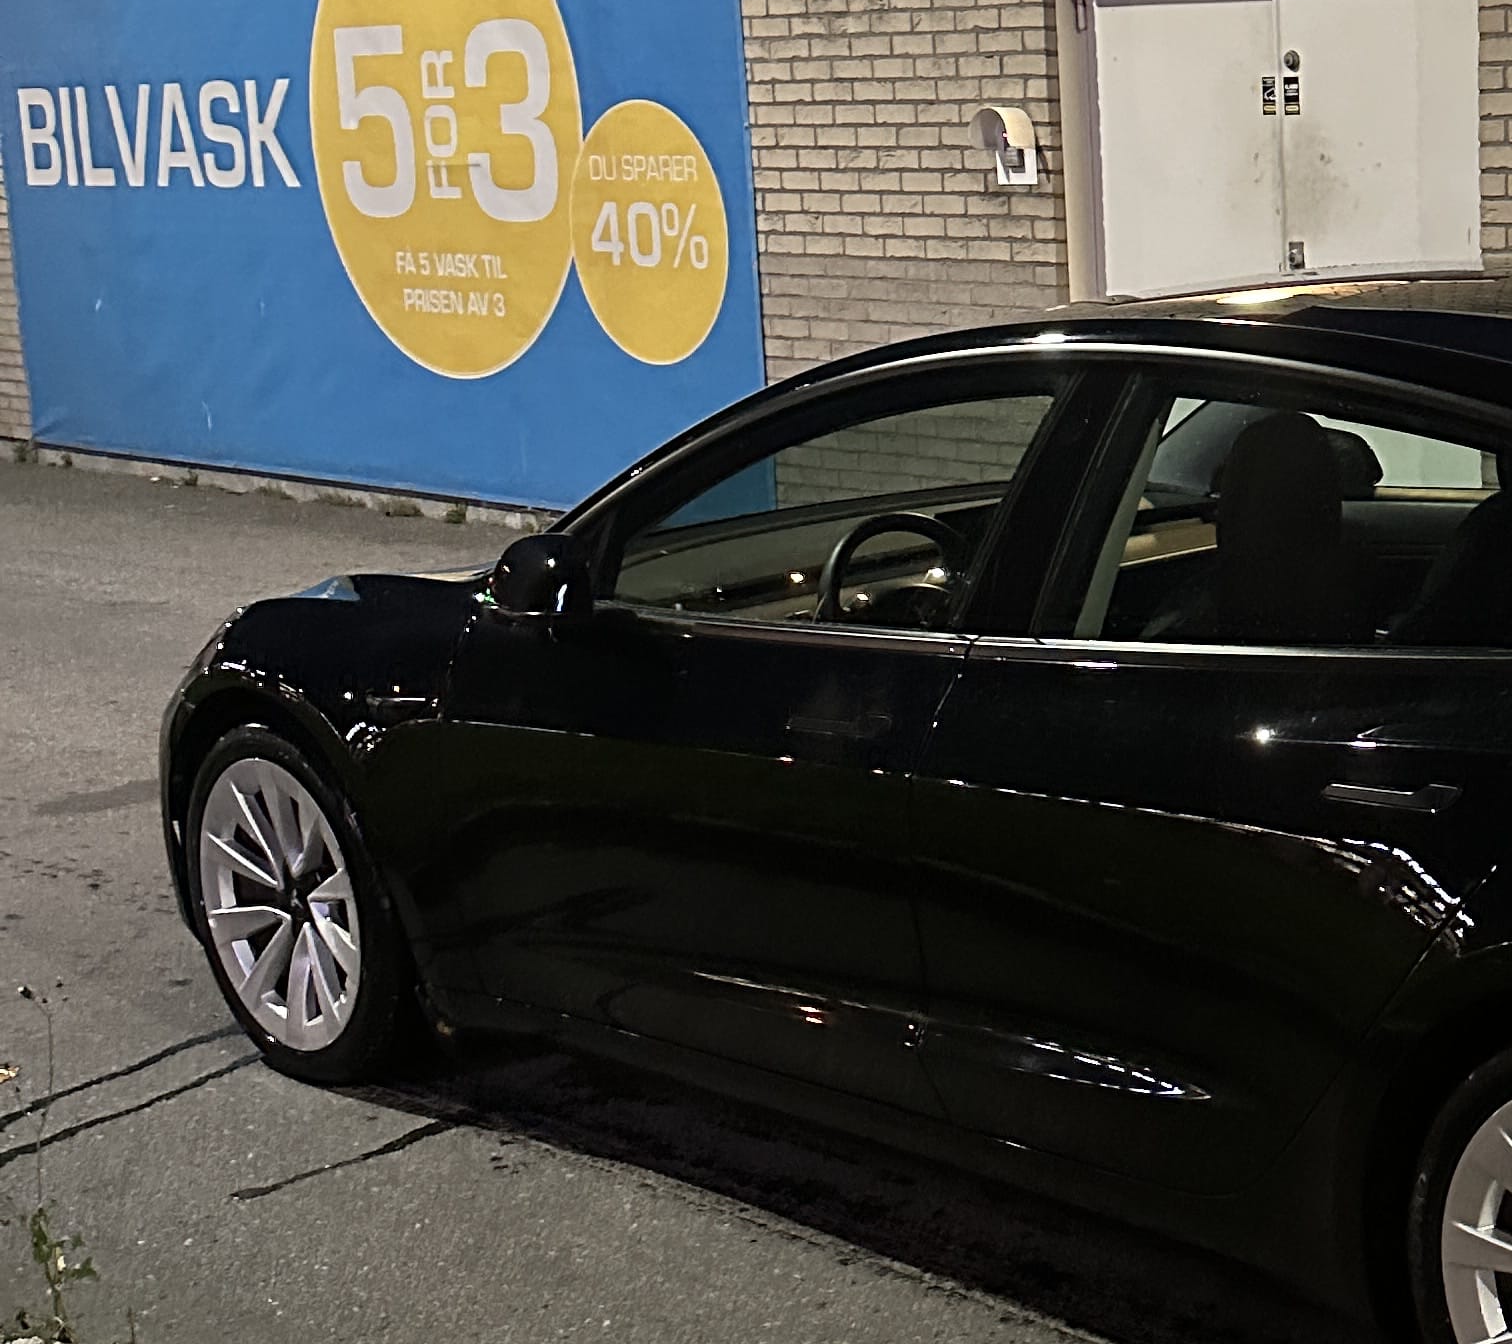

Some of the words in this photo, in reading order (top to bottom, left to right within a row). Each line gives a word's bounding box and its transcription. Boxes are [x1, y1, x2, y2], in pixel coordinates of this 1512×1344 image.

[17, 78, 301, 188] BILVASK
[334, 25, 416, 218] 5
[420, 50, 462, 198] FOR
[464, 18, 558, 222] 3
[589, 155, 617, 181] DU
[621, 155, 698, 181] SPARER
[591, 201, 709, 269] 40%
[418, 252, 430, 275] 5
[434, 253, 479, 278] VASK
[481, 254, 508, 279] TIL
[403, 288, 464, 314] PRISEN
[467, 291, 489, 315] AV
[492, 292, 506, 317] 3
